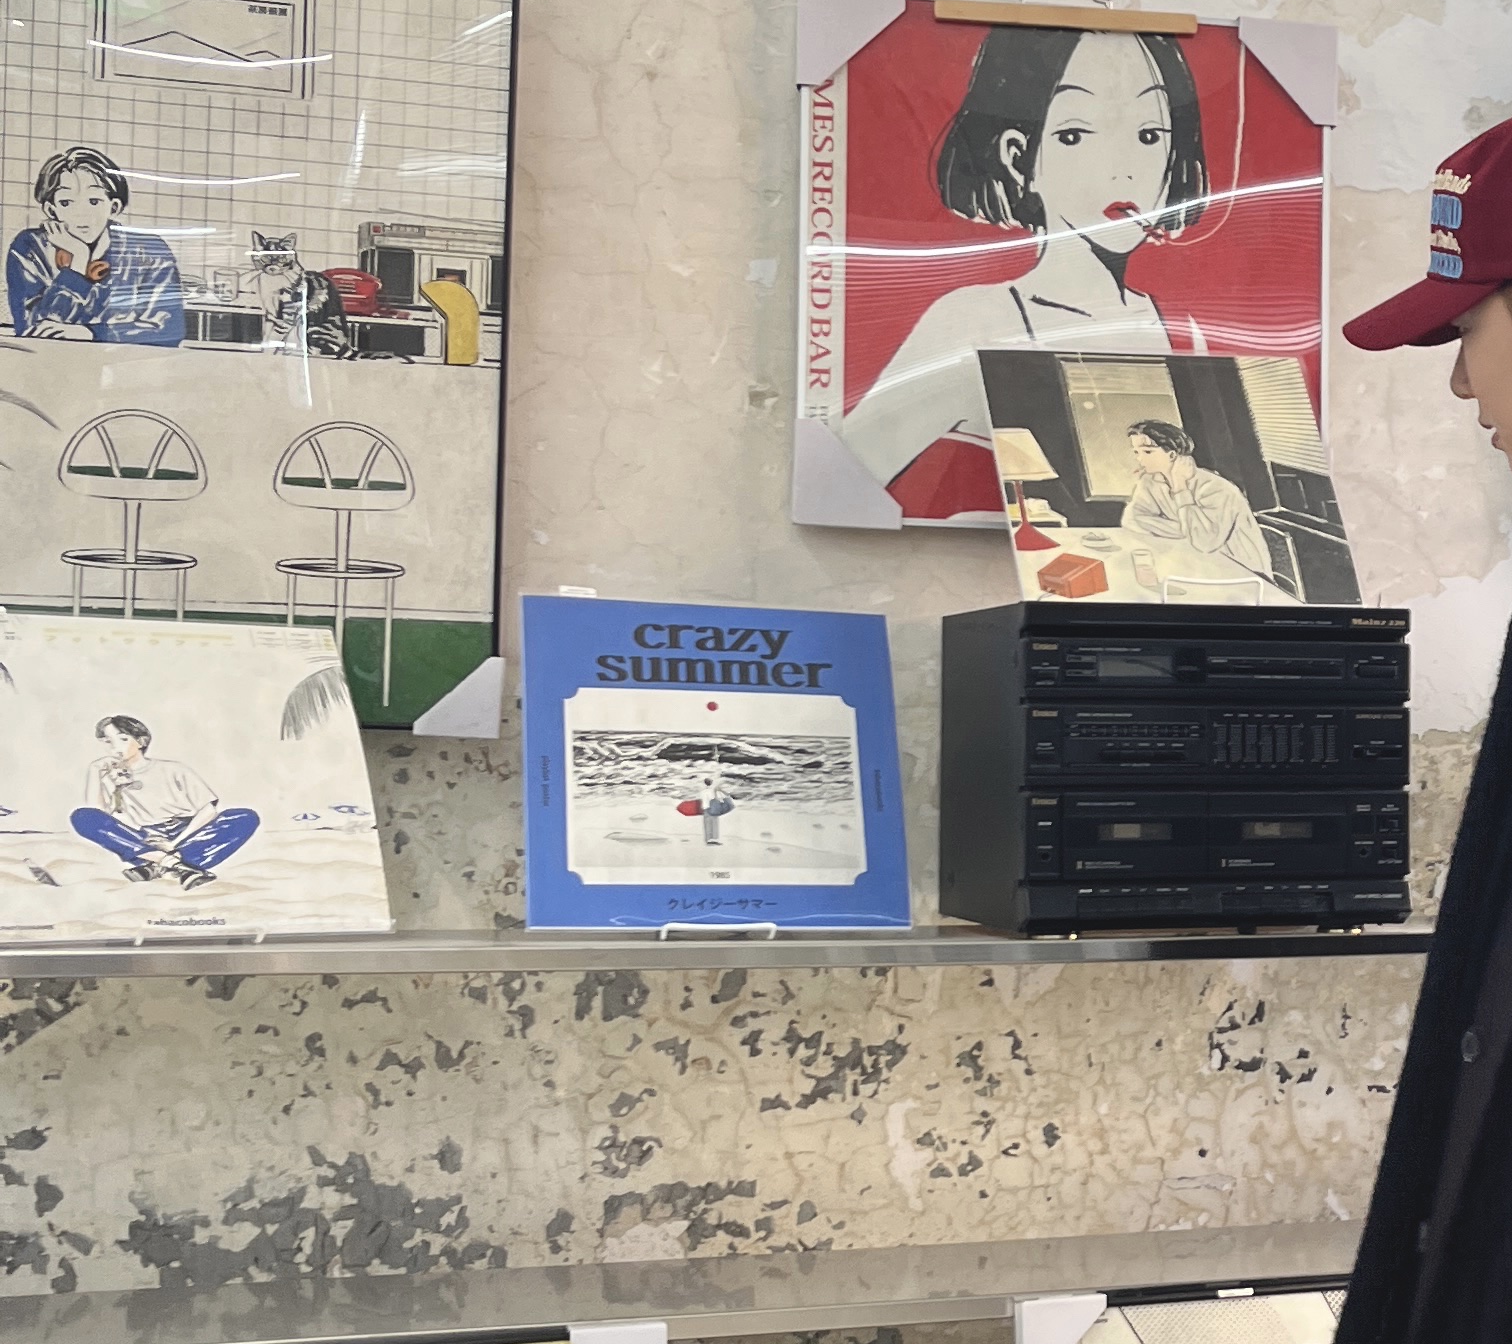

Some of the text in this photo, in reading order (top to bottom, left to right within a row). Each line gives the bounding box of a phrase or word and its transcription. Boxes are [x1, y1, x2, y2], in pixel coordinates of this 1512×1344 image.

[810, 159, 834, 311] RECORD
[808, 316, 833, 390] BAR
[633, 623, 793, 660] crazy
[596, 654, 833, 688] summer
[667, 897, 777, 910] クレイジーサマー
